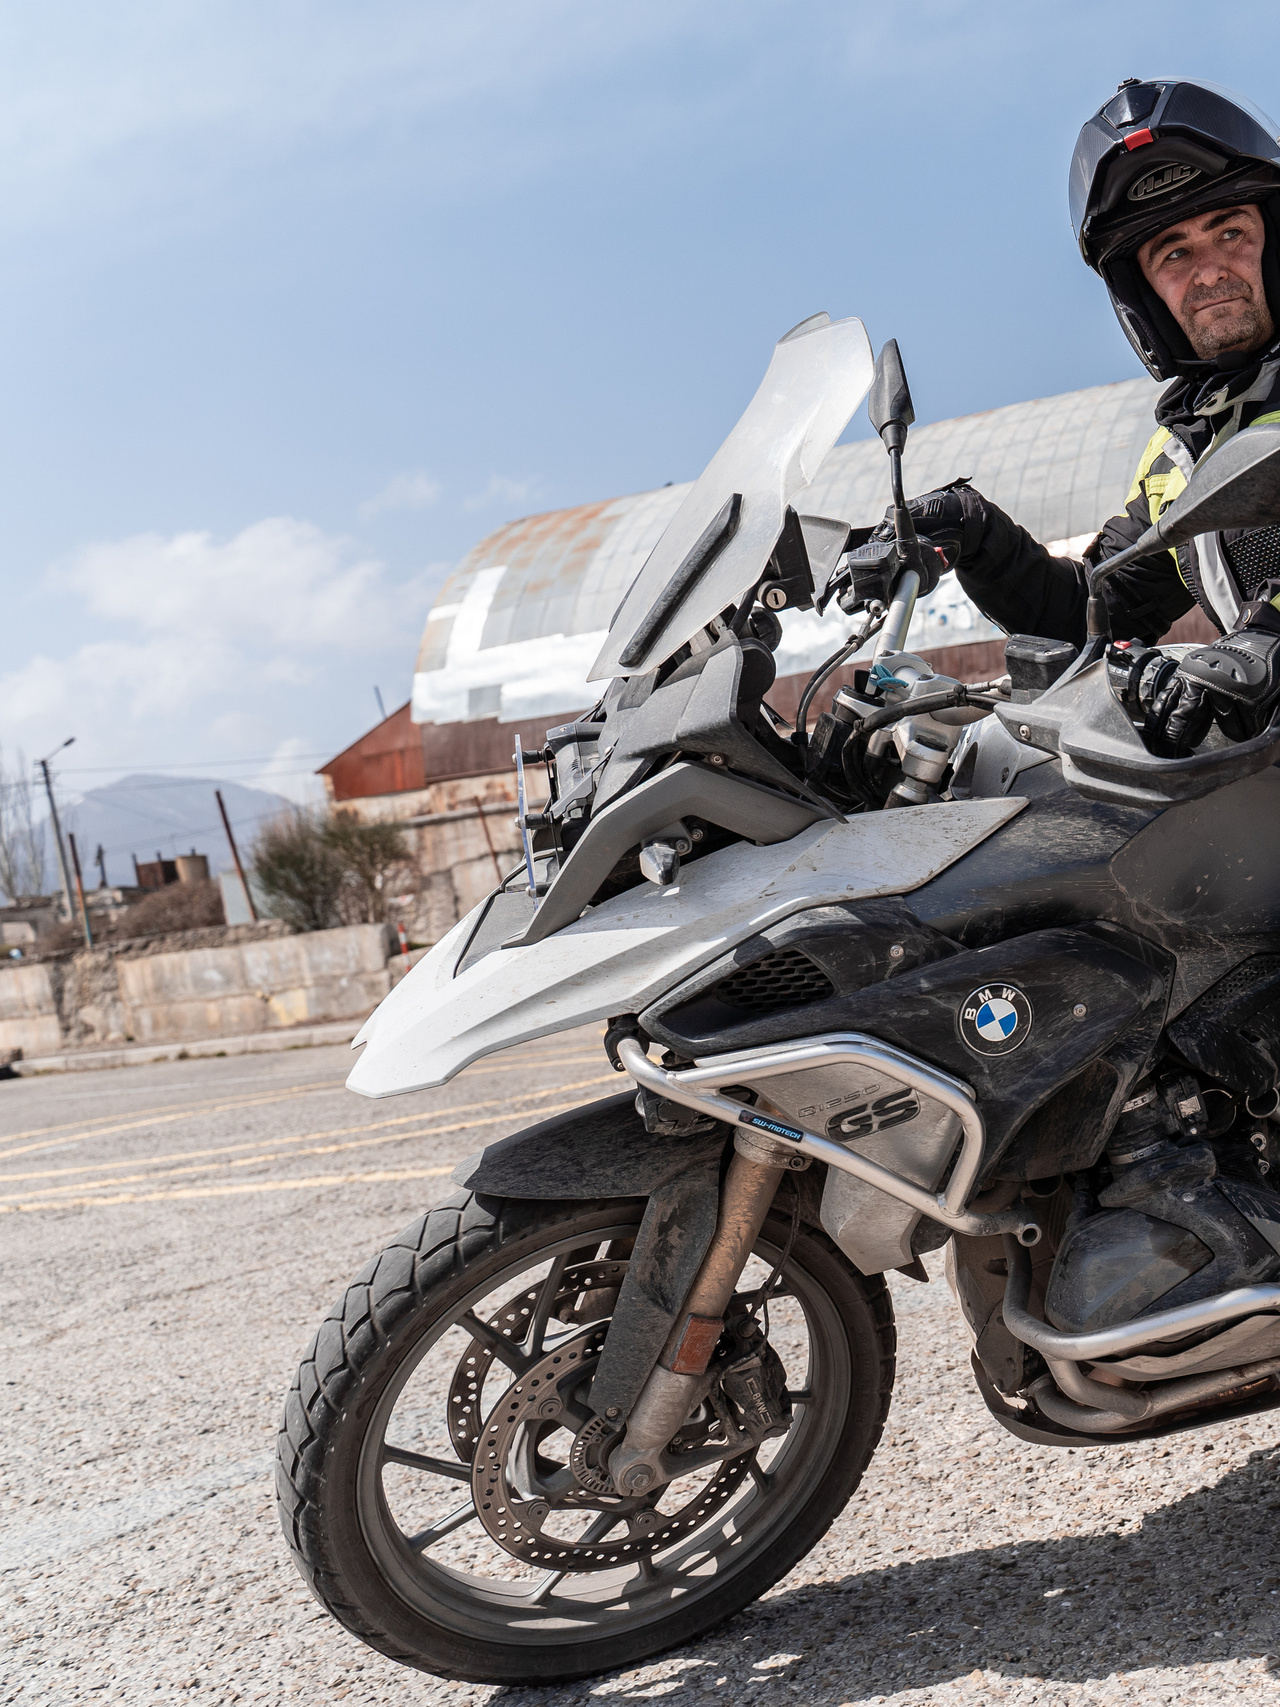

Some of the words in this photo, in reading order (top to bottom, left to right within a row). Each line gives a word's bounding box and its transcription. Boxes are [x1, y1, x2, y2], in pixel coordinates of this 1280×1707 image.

[1137, 165, 1191, 198] HJC
[963, 988, 1016, 1021] BMW
[751, 1117, 802, 1140] SW-MOTECH
[827, 1087, 919, 1142] GS
[752, 1392, 768, 1414] BMW
